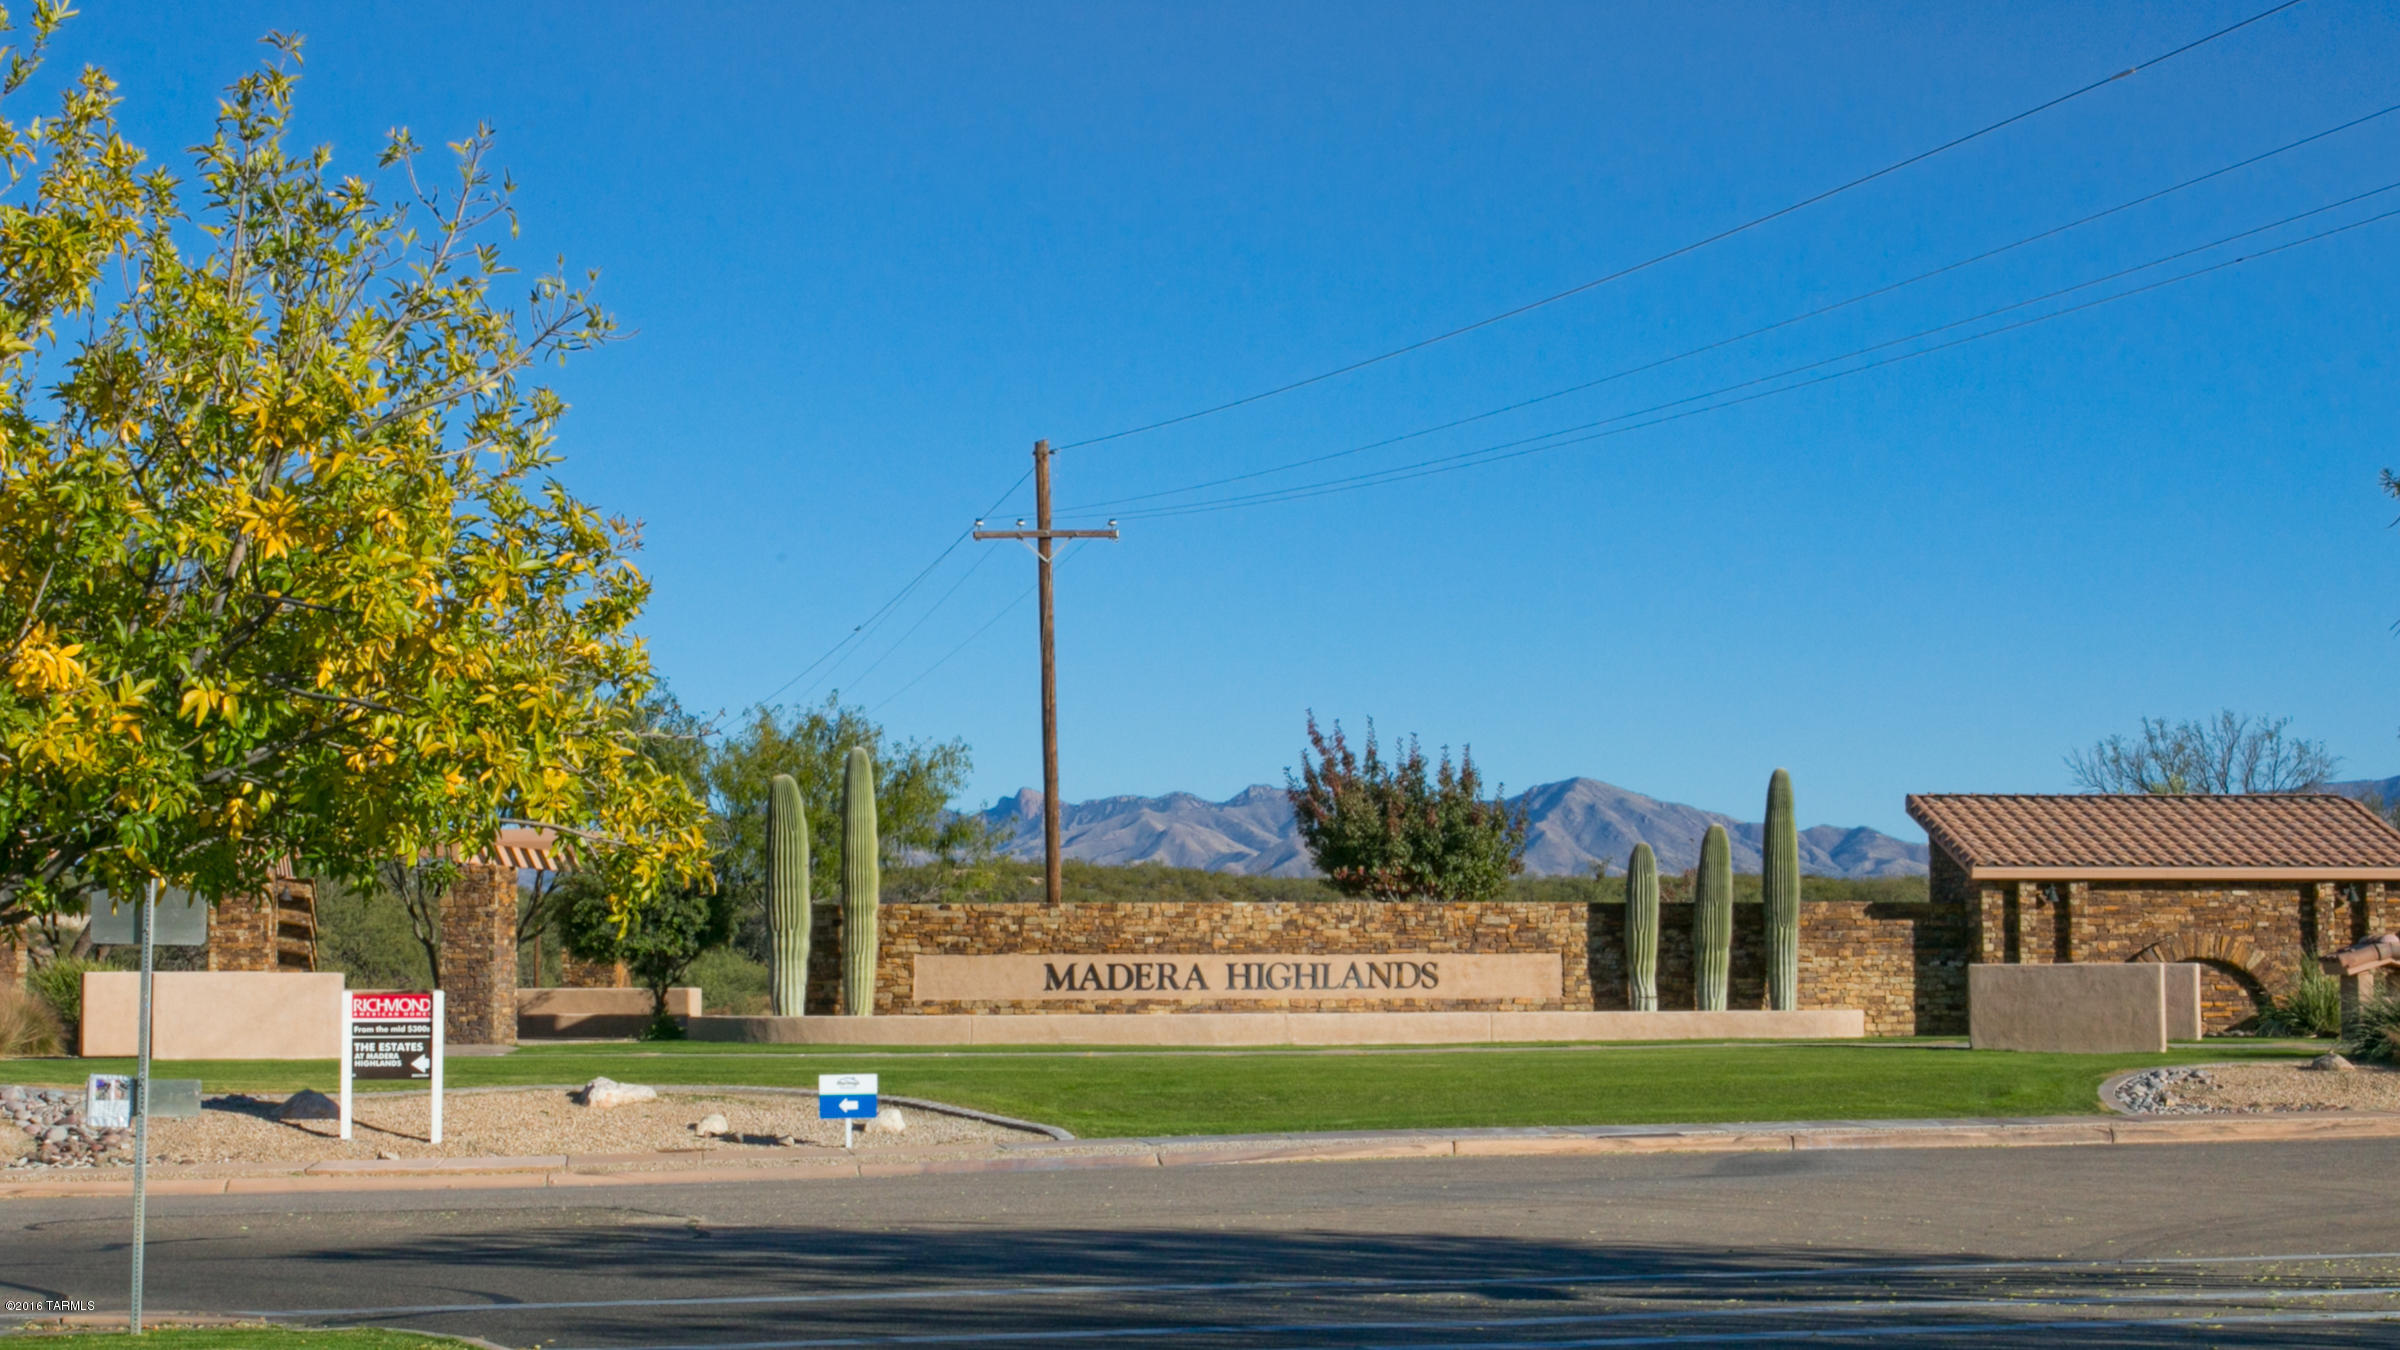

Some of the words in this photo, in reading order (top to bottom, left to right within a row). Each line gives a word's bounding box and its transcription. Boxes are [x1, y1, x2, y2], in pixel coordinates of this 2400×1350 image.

[1044, 962, 1209, 991] MADERA
[1225, 961, 1439, 991] HIGHLANDS
[353, 998, 431, 1012] RICHMOND
[353, 1025, 374, 1033] From
[375, 1025, 389, 1033] the
[390, 1025, 406, 1033] mid
[354, 1042, 376, 1052] THE
[378, 1042, 424, 1052] ESTATES
[354, 1052, 365, 1060] AT
[366, 1052, 399, 1060] MADERA
